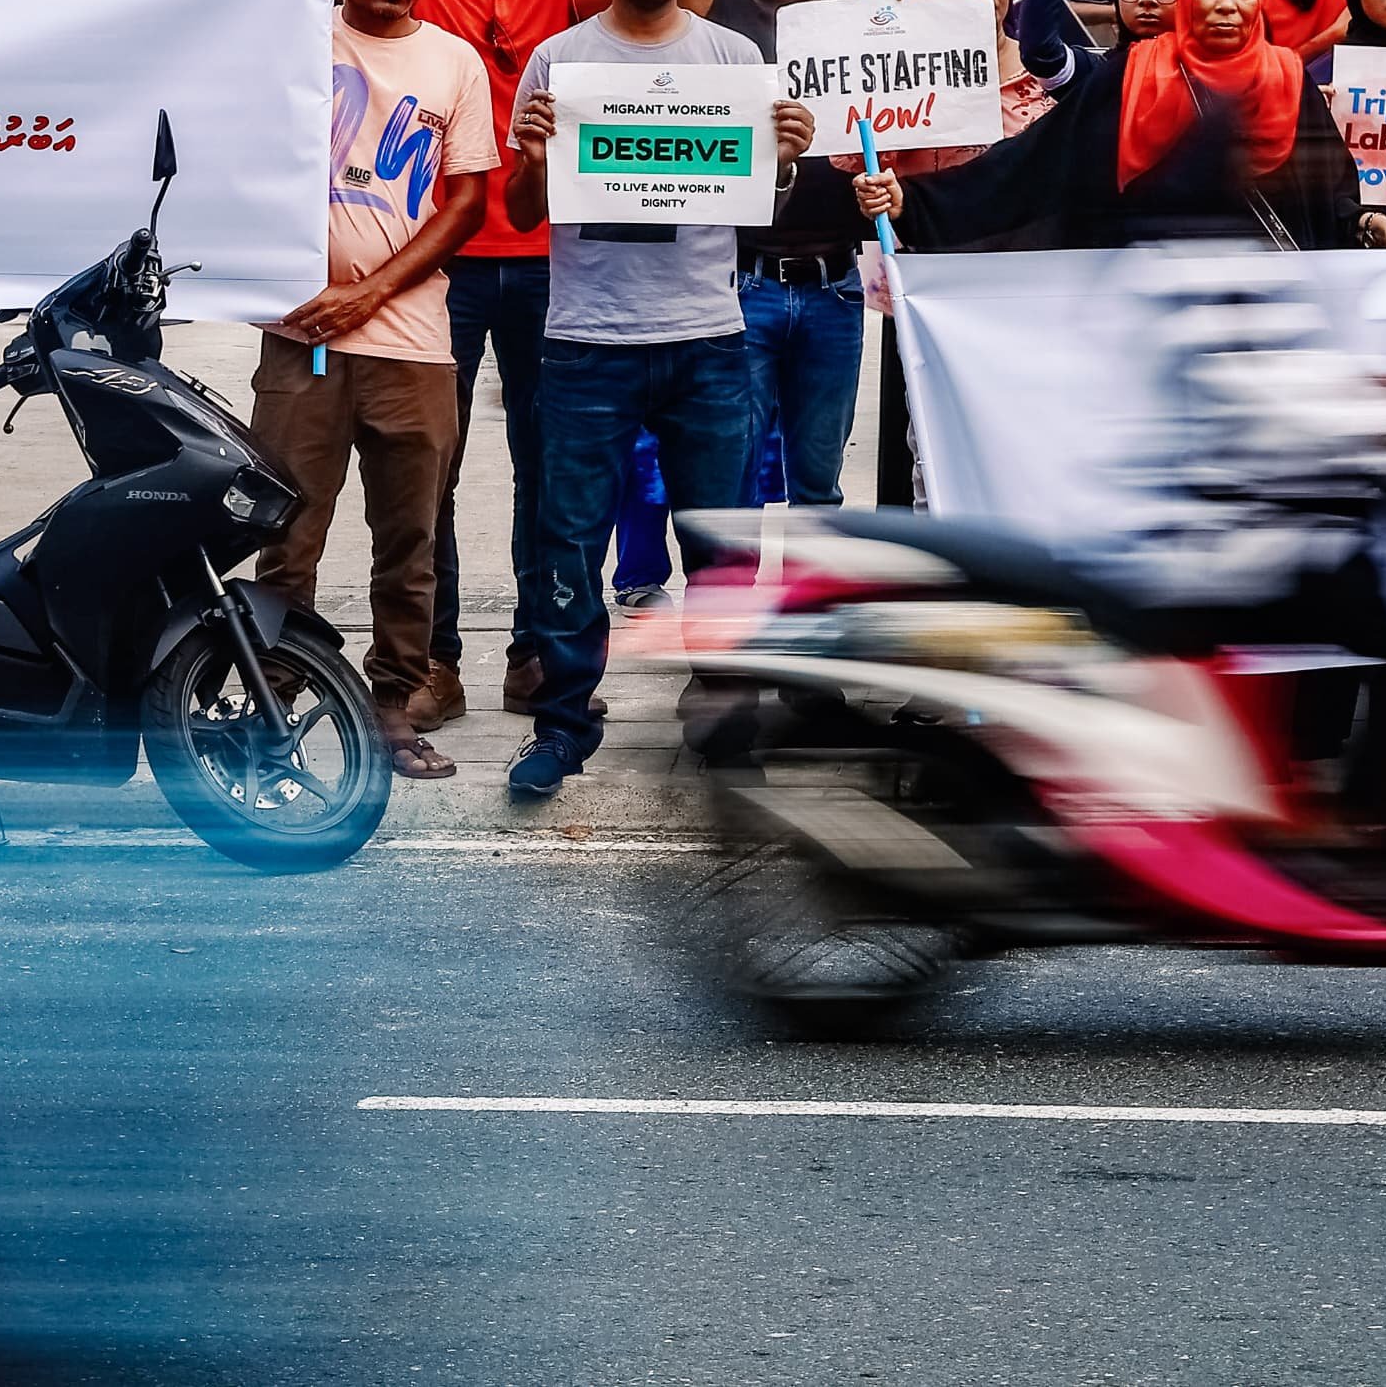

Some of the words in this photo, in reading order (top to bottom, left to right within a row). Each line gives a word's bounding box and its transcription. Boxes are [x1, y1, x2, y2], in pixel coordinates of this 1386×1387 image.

[787, 56, 852, 100] SAFE
[860, 49, 988, 94] STAFFING
[603, 104, 664, 115] MIGRANT
[667, 105, 731, 116] WORKERS
[591, 136, 740, 163] DESERVE
[345, 166, 372, 181] AUG
[604, 182, 621, 192] TO
[623, 183, 649, 192] LIVE
[651, 183, 675, 193] AND
[677, 184, 711, 193] WORK
[714, 184, 725, 194] IN
[641, 198, 687, 208] DIGNITY
[125, 490, 192, 502] HONDA
